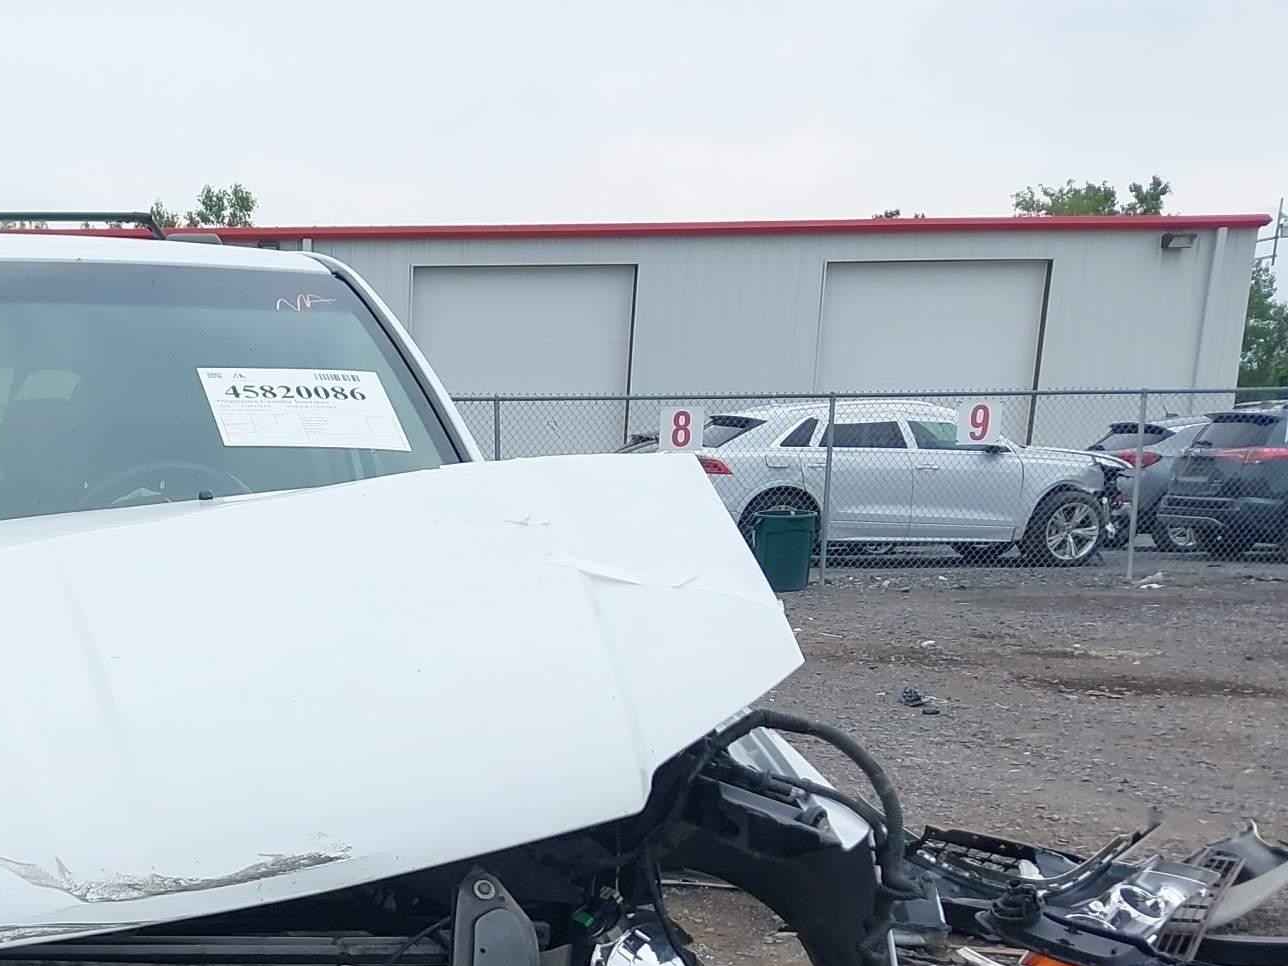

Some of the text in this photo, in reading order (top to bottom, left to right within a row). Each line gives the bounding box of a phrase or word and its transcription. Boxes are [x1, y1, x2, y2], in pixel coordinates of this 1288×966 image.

[224, 384, 367, 401] 45820086
[670, 410, 692, 448] 8
[969, 404, 991, 442] 9
